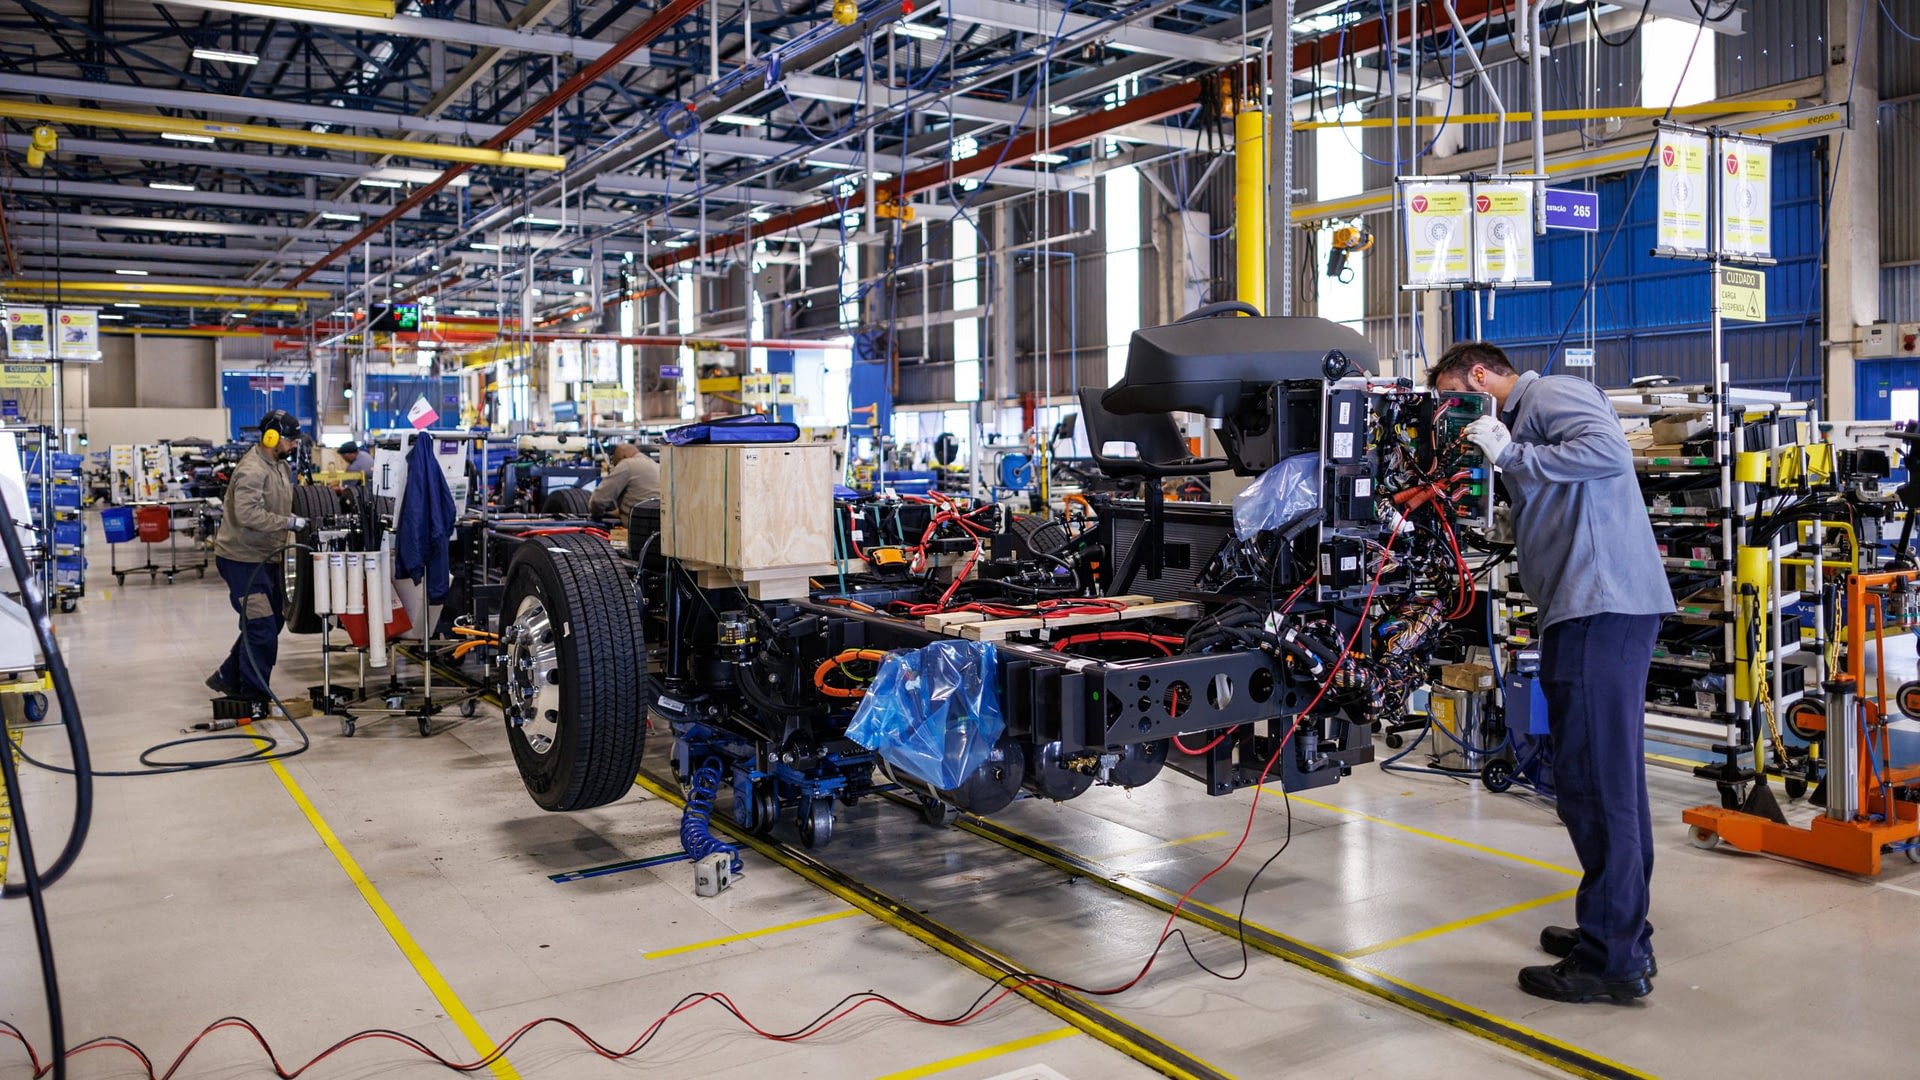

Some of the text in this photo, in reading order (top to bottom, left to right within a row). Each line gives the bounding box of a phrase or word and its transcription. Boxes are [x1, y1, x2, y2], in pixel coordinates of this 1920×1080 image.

[1808, 112, 1835, 124] eepos
[1546, 204, 1591, 218] ESTAÇÃO 265
[1726, 271, 1756, 286] CUIDADO
[1721, 290, 1737, 300] CARGA
[1721, 302, 1745, 312] SUSPENSA
